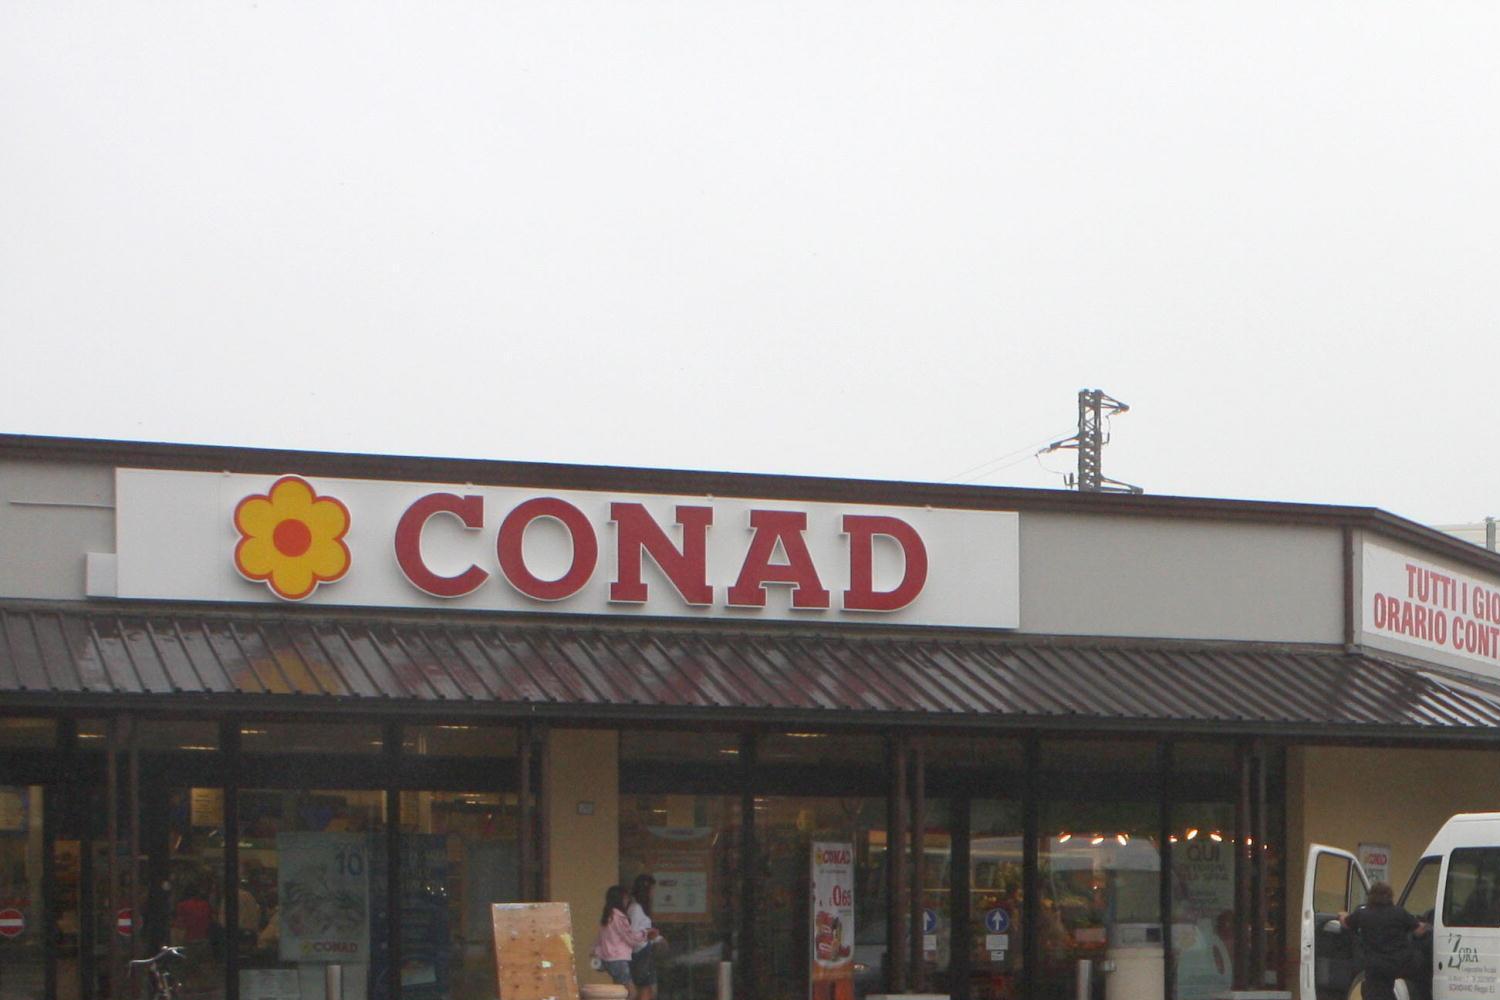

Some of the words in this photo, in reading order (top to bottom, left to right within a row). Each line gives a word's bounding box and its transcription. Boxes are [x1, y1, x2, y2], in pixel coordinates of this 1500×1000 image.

[394, 492, 928, 611] CONAD
[1406, 563, 1457, 611] TUTTI
[1462, 582, 1468, 614] I
[1373, 593, 1447, 645] ORARIO
[1186, 844, 1221, 862] QUI
